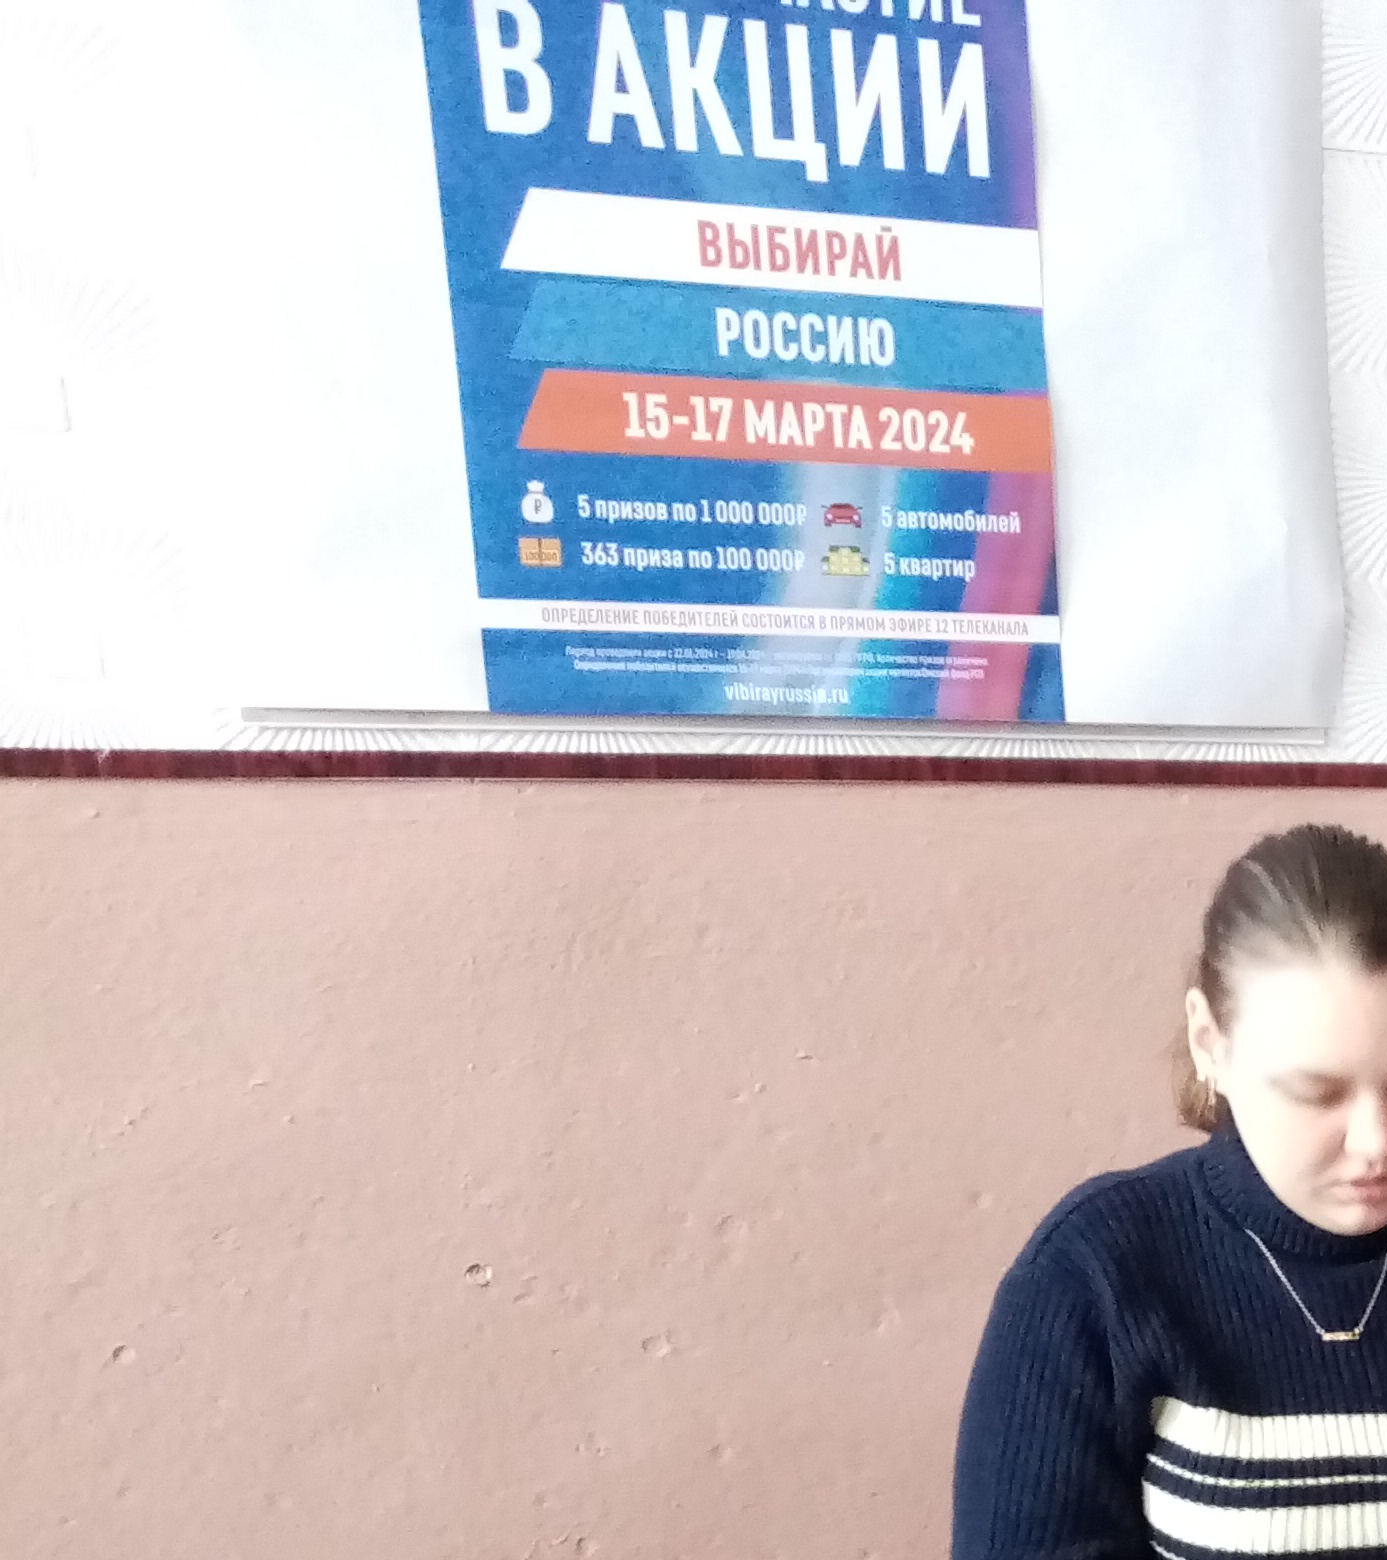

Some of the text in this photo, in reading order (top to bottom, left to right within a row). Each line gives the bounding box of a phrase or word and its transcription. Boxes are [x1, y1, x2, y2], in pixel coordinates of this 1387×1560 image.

[472, 0, 991, 182] В АКЦИИ
[697, 219, 902, 282] ВЫБИРАЙ
[714, 306, 896, 368] РОССИЮ
[622, 391, 975, 455] 15-17 МАРТА 2024
[577, 493, 591, 519] 5
[595, 498, 669, 524] призов
[672, 501, 697, 522] по
[880, 505, 1022, 534] 5 автомобилей
[580, 541, 619, 567] 363
[623, 546, 684, 572] приза
[688, 548, 713, 570] по
[716, 546, 752, 570] 100
[883, 552, 976, 583] 5 квартир
[541, 606, 1029, 637] ОПРЕДЕЛЕНИЕ ПОБЕДИТЕЛЕЙ СОСТОИТСЯ В ПРЯМОМ ЭФИРЕ 12 ТЕЛЕКАНАЛА
[723, 681, 849, 706] vibirayrussia.ru
